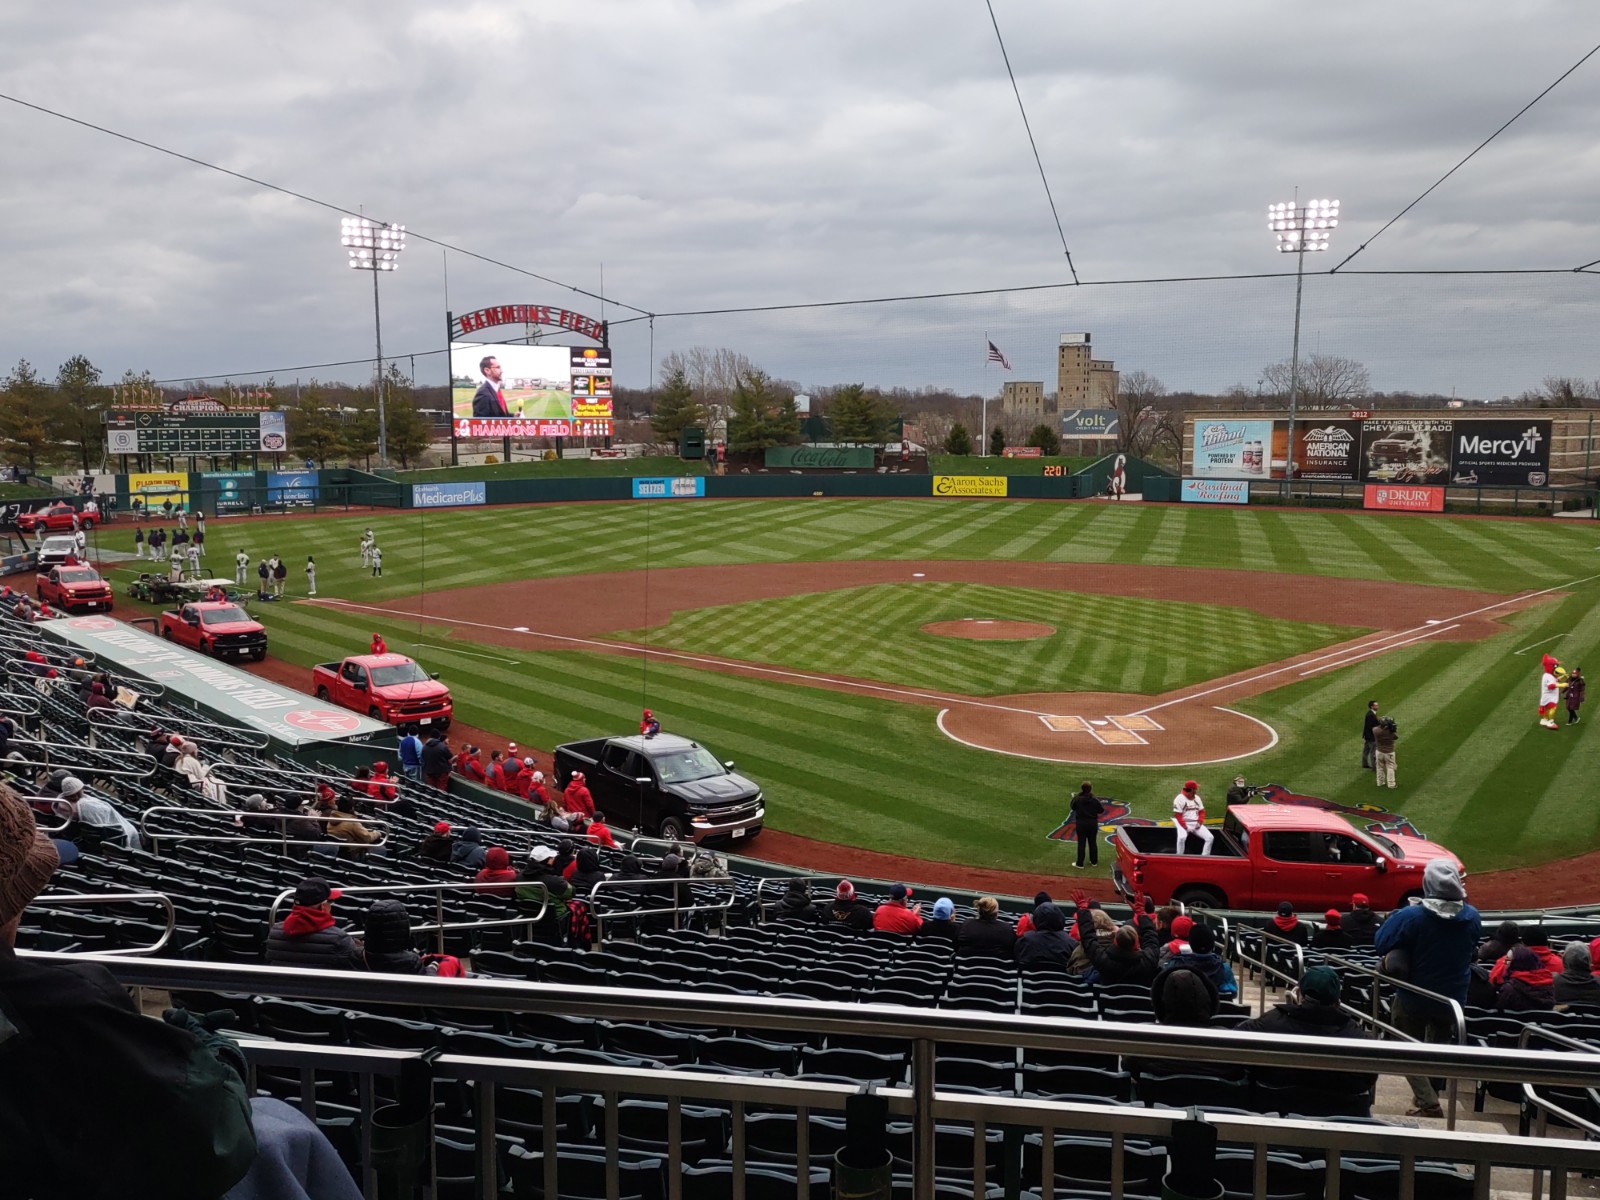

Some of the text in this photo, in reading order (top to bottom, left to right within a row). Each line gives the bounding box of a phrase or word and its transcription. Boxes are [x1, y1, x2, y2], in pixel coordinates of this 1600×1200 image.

[459, 304, 603, 339] HAMMONS FIELD
[1076, 414, 1106, 426] volt
[472, 424, 536, 436] HAMMONS
[540, 424, 570, 436] FIELD
[1306, 442, 1350, 450] AMERICAN
[1460, 436, 1524, 459] Mercy
[950, 477, 1004, 486] Aaron Sachs
[952, 486, 992, 494] Associates
[1196, 482, 1244, 492] Cardinal
[414, 488, 485, 505] MedicarePlus
[1196, 491, 1240, 501] Roofing
[1389, 490, 1431, 500] DRURY
[88, 629, 170, 654] WELCOME
[170, 659, 255, 691] HAMMONS
[226, 688, 301, 710] FIELD
[348, 734, 371, 743] Mercy
